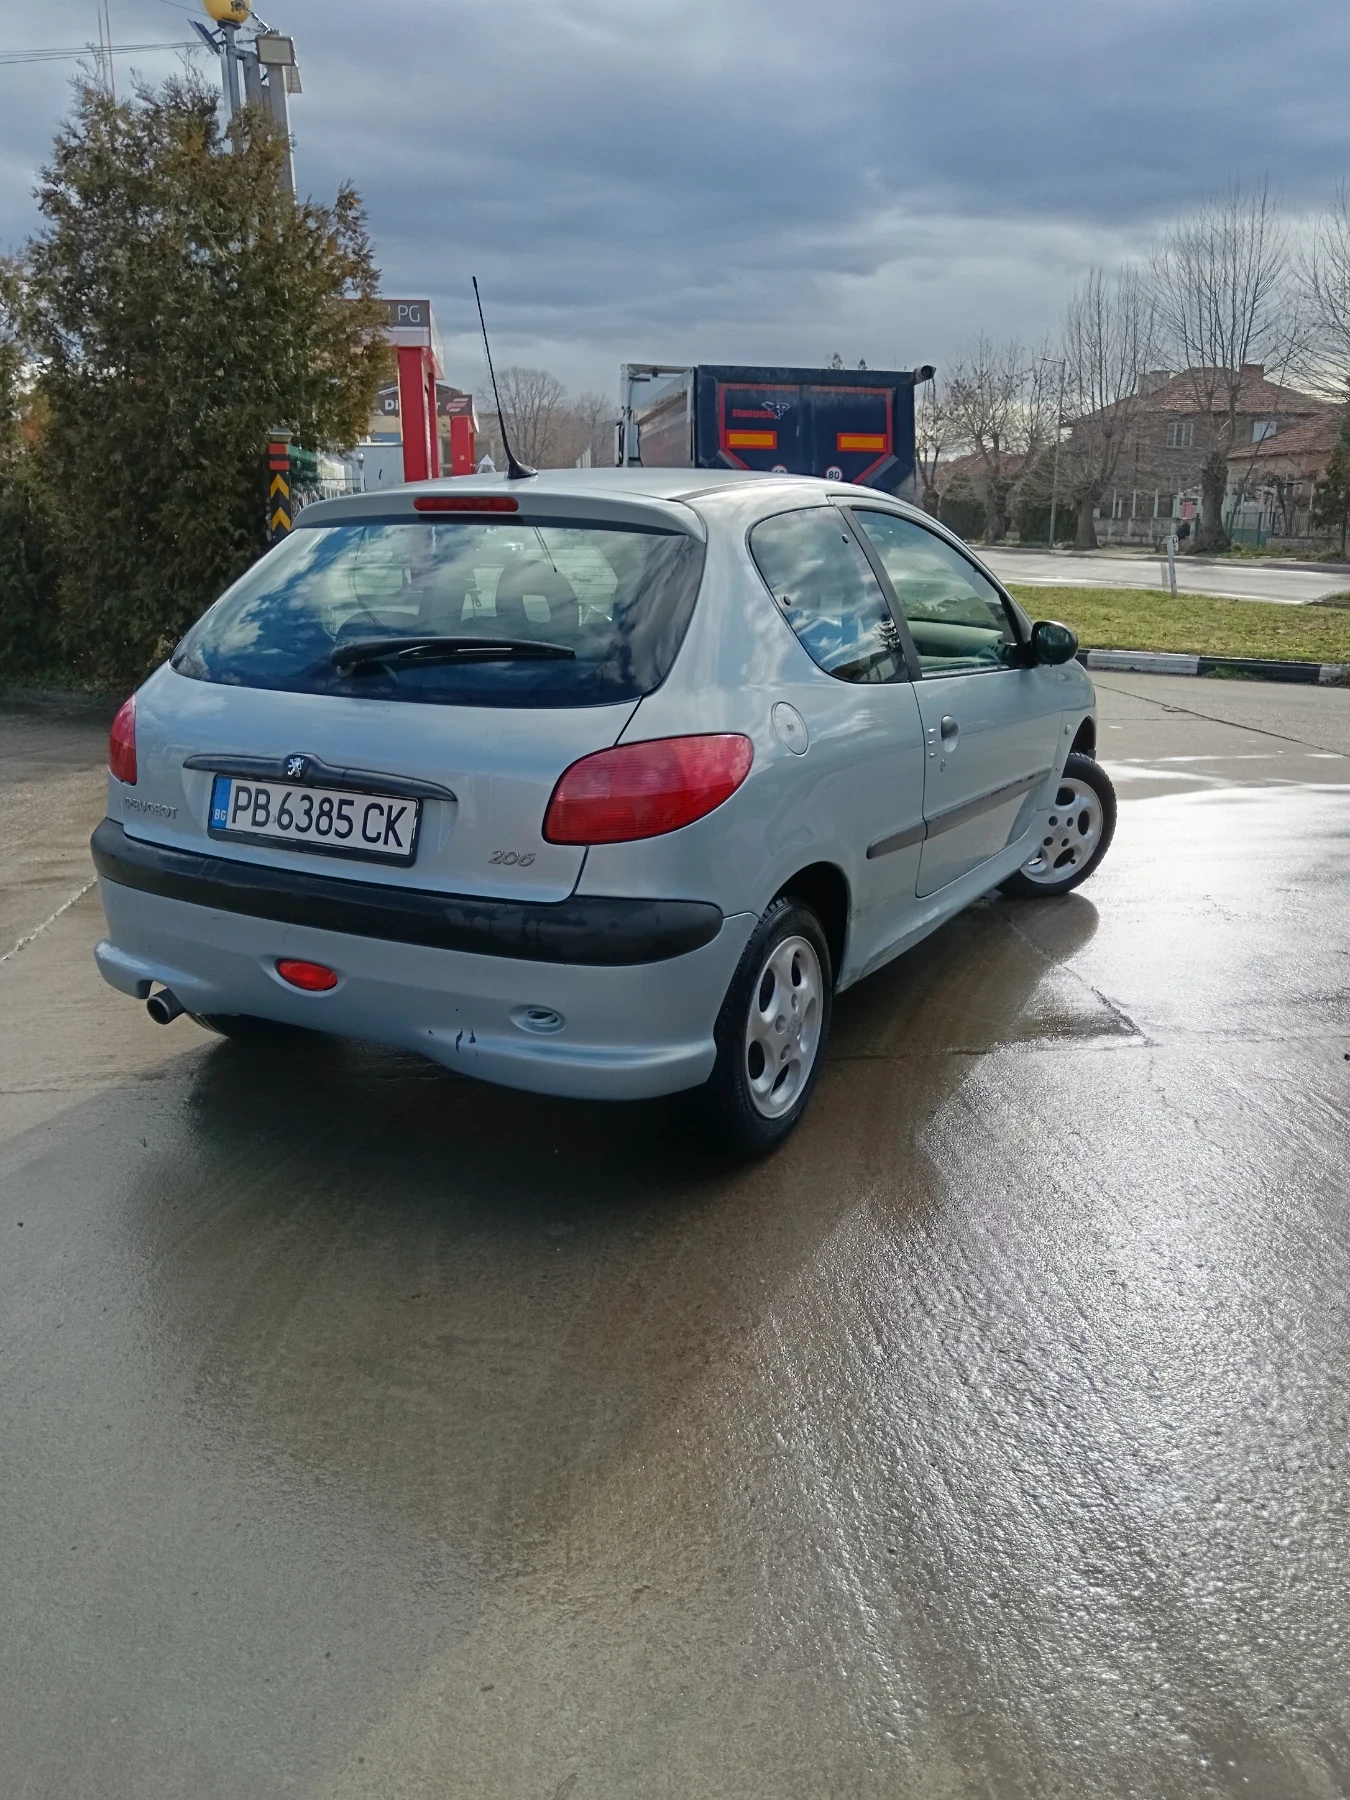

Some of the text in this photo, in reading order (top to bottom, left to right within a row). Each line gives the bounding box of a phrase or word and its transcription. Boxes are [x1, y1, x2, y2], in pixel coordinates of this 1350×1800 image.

[388, 305, 420, 322] PG
[828, 470, 840, 480] 80
[125, 797, 178, 819] PEUGEOT
[214, 785, 408, 847] BG PB 6385 CK
[488, 849, 536, 867] 206
